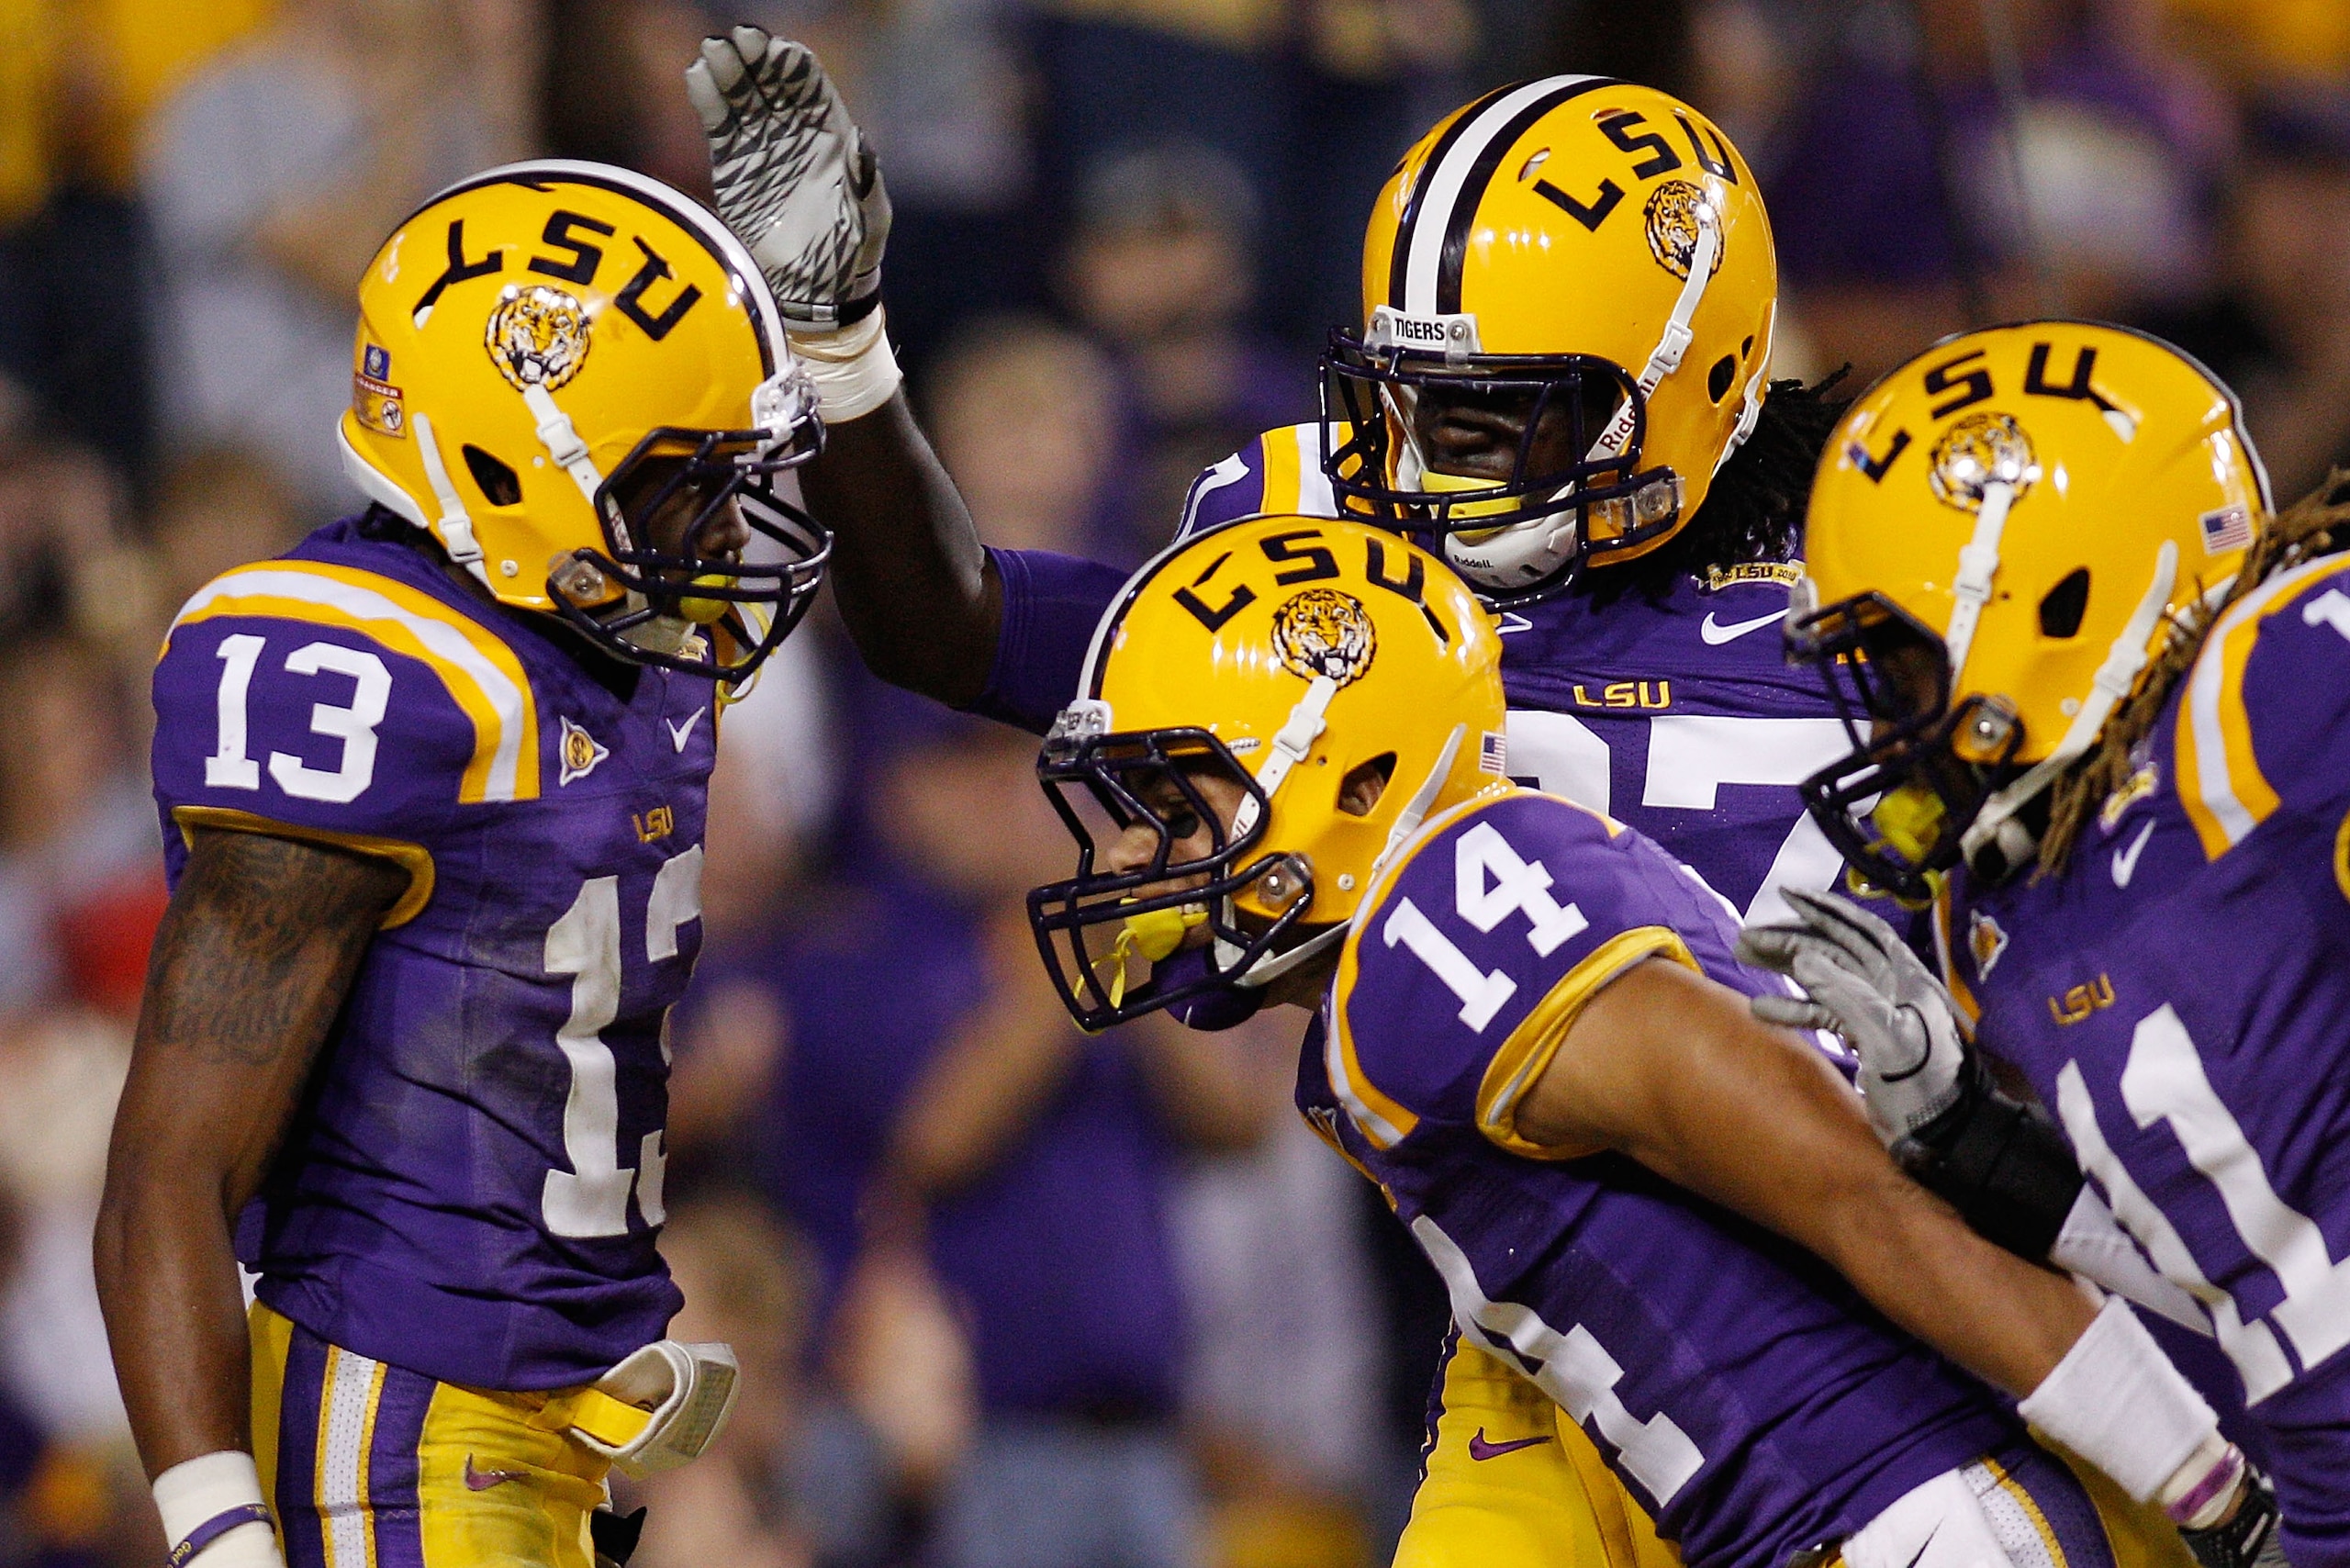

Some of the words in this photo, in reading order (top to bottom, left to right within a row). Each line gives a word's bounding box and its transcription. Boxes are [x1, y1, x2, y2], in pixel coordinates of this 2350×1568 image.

[1533, 111, 1739, 232] LSU
[444, 209, 704, 342] LSU
[1394, 318, 1445, 342] TIGERS
[1599, 378, 1656, 451] Riddll
[1847, 343, 2098, 484] LSU
[1172, 530, 1424, 633] LSU
[1454, 554, 1494, 568] Riddell
[1736, 566, 1774, 579] LSU
[205, 633, 392, 803] 13
[1572, 681, 1671, 710] LSU
[632, 806, 674, 843] LSU
[1384, 821, 1589, 1033] 14
[2048, 973, 2116, 1026] LSU
[2056, 1002, 2350, 1407] 11
